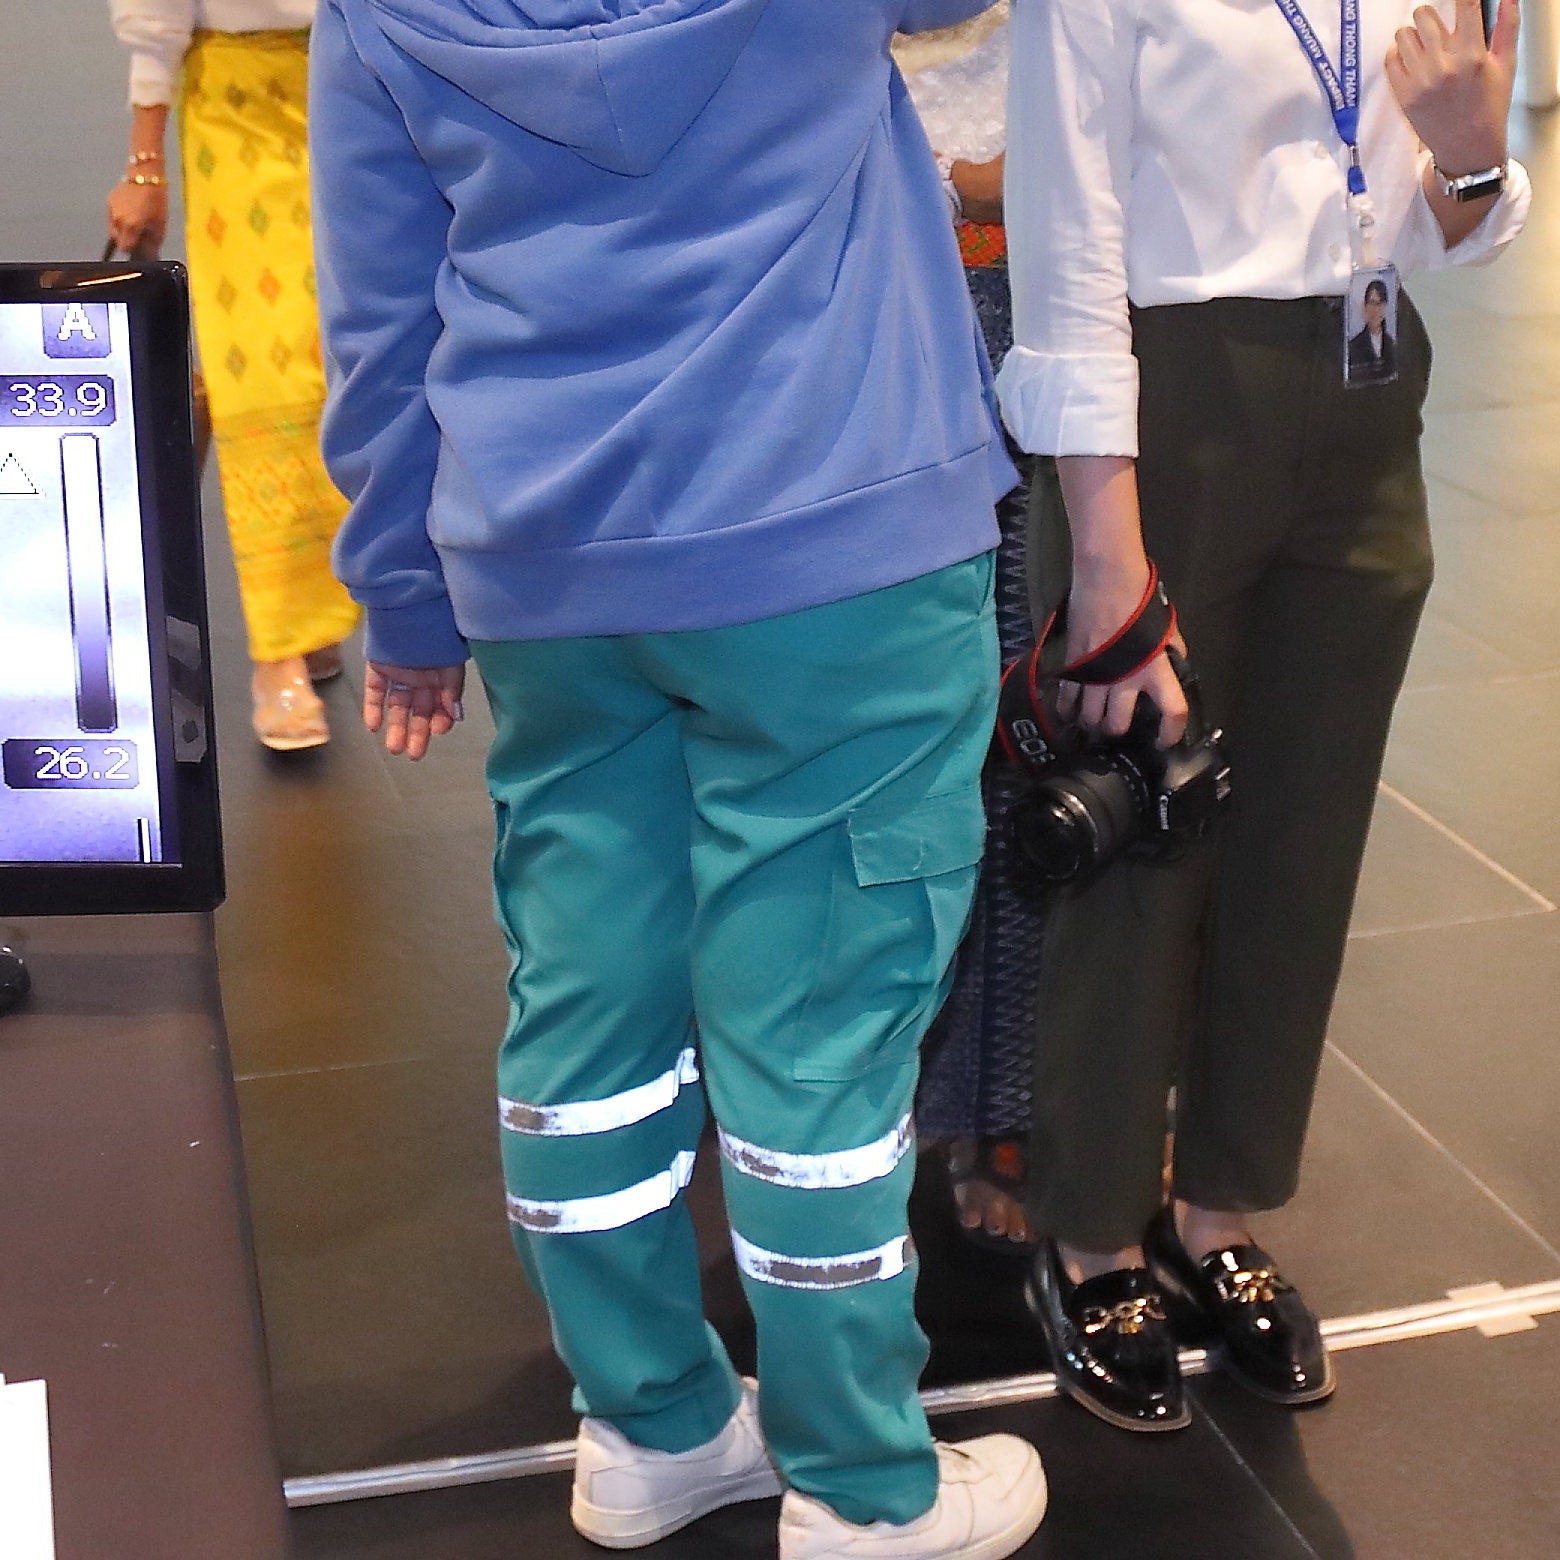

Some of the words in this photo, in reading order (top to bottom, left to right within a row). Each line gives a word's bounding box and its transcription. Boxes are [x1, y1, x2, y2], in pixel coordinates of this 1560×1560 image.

[1292, 16, 1324, 58] MUANG
[1345, 23, 1357, 67] THONG
[57, 303, 97, 341] A
[9, 381, 107, 417] 33.9
[34, 745, 131, 780] 26.2
